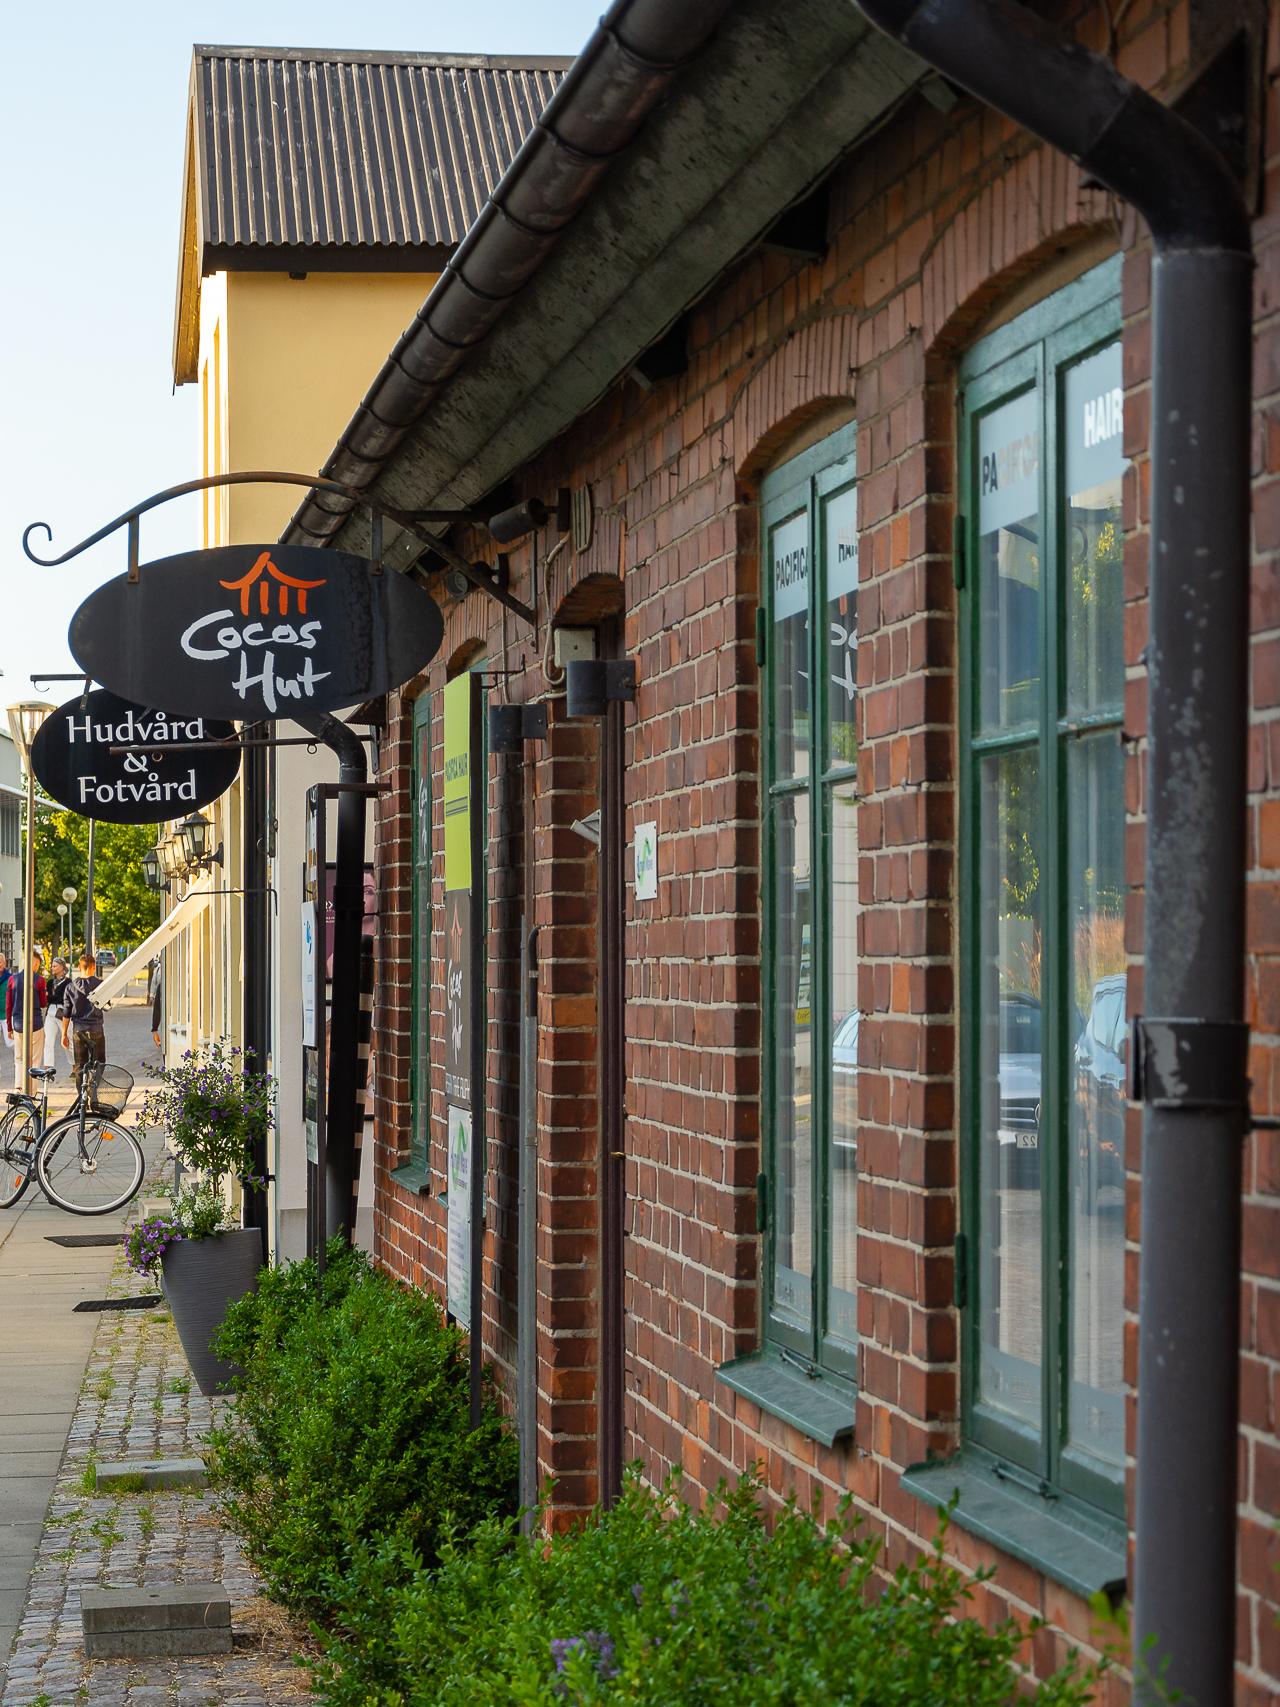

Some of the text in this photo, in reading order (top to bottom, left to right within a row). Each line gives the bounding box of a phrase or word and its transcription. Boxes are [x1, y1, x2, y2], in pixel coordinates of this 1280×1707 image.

[1083, 386, 1124, 449] HAIR
[181, 609, 322, 660] Cocos
[232, 650, 331, 713] Hut
[66, 710, 203, 743] Hudvård
[123, 745, 148, 773] &
[77, 768, 197, 804] Fotvård
